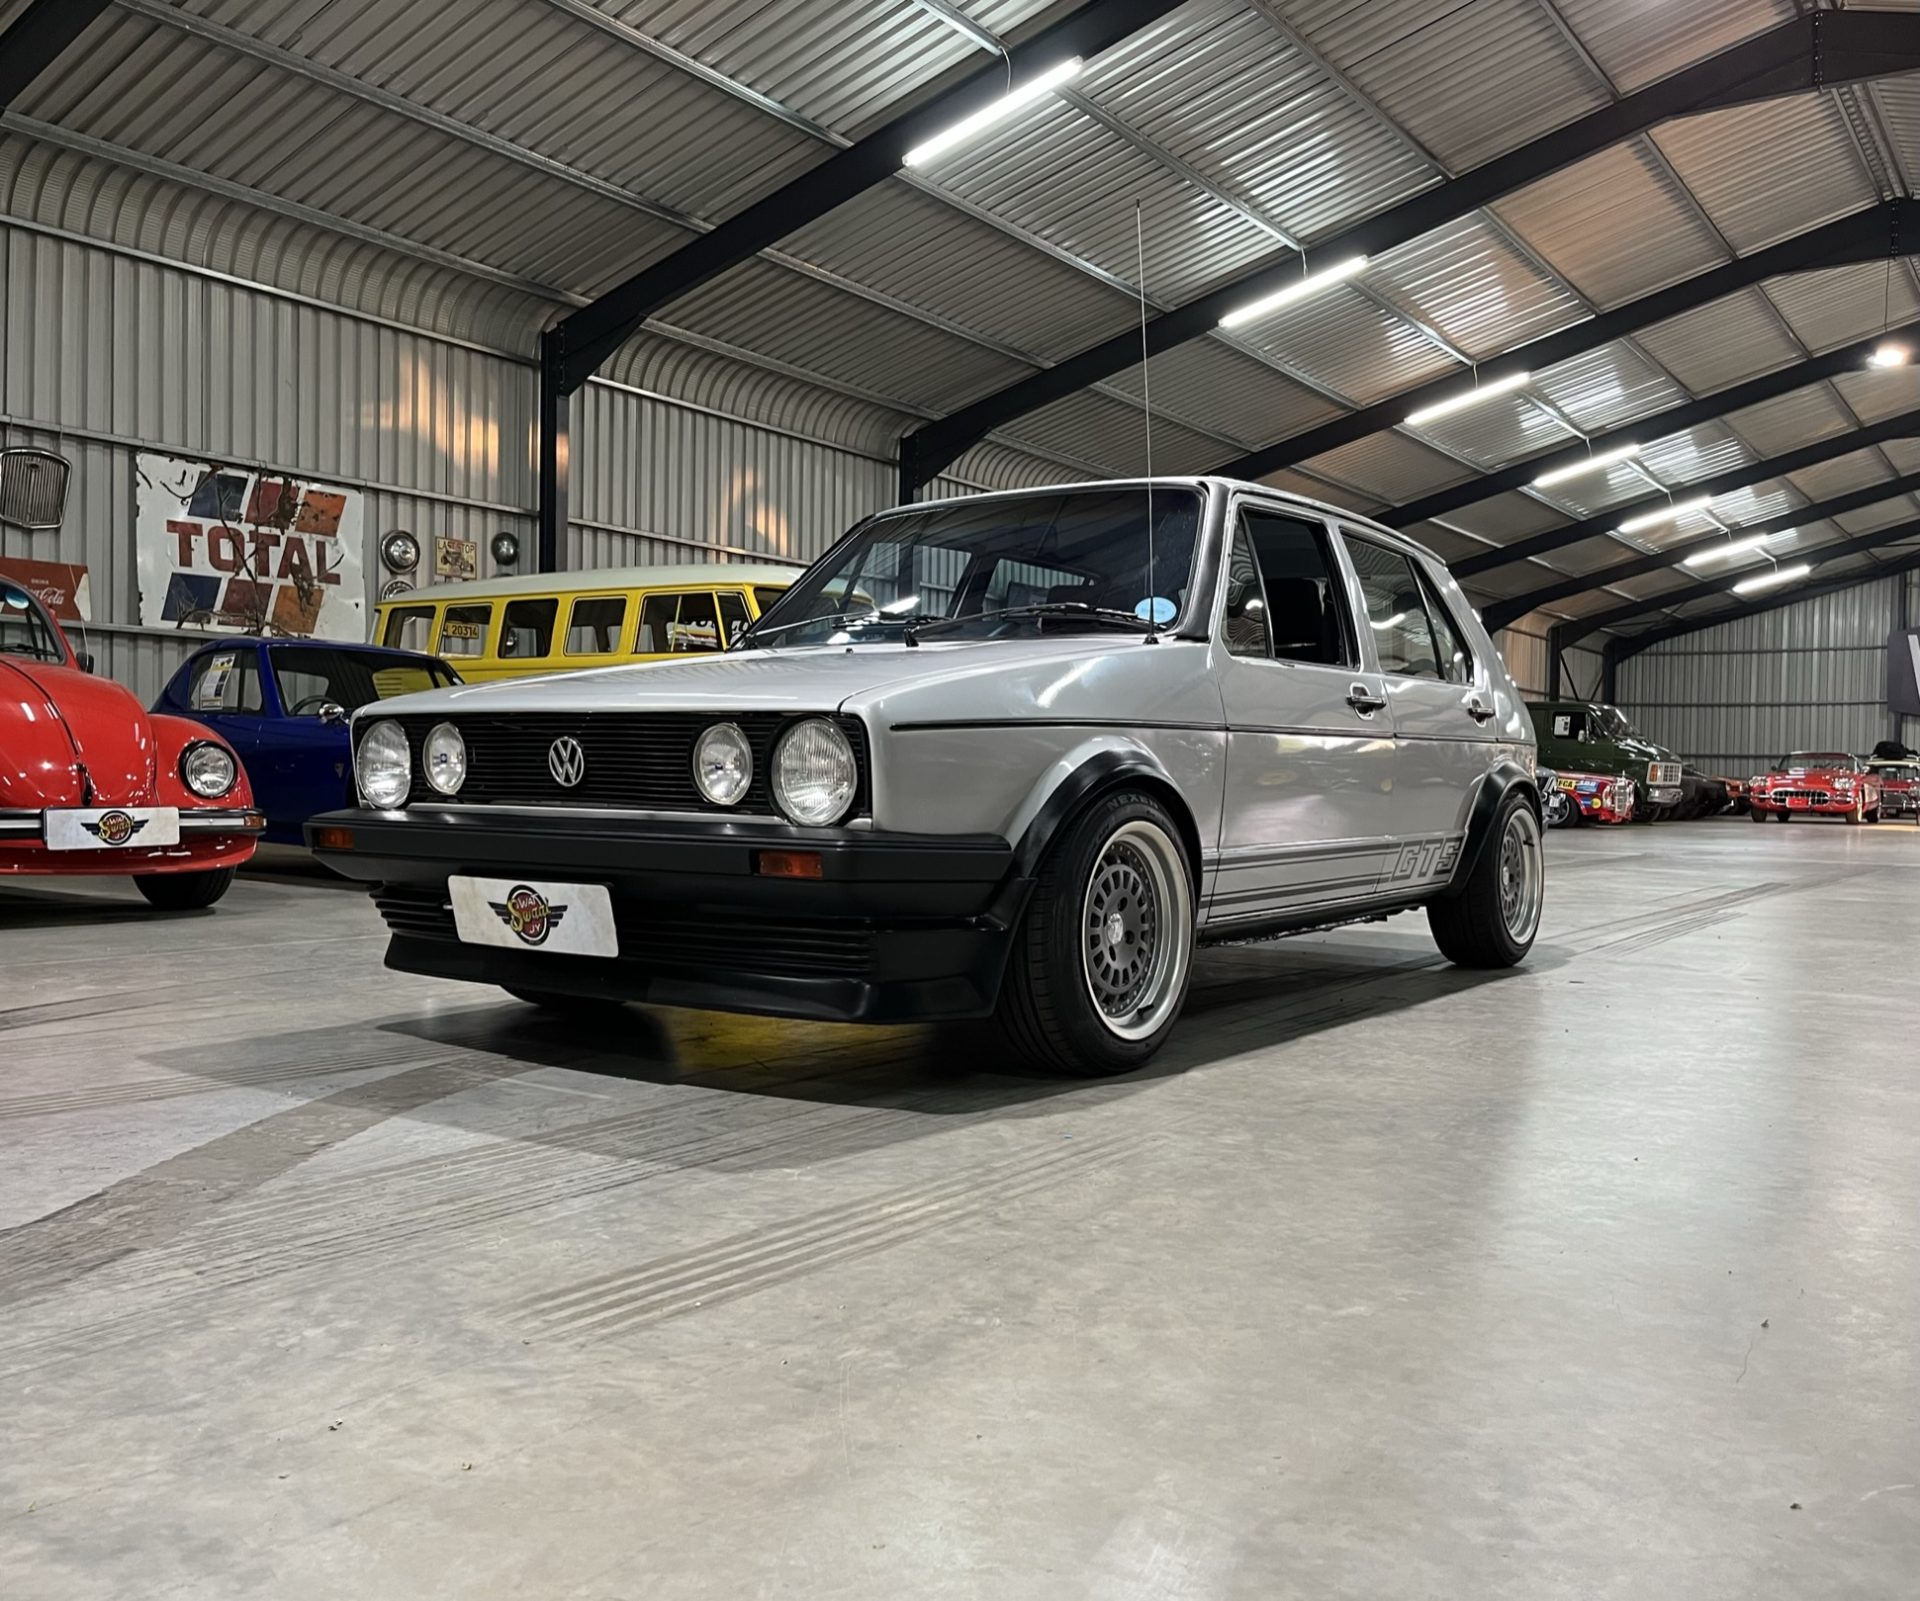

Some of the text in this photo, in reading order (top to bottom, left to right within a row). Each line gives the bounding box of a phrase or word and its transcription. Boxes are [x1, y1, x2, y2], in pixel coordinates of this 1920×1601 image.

[166, 519, 341, 585] TOTAL
[549, 736, 584, 787] VW
[1393, 841, 1461, 879] GTS
